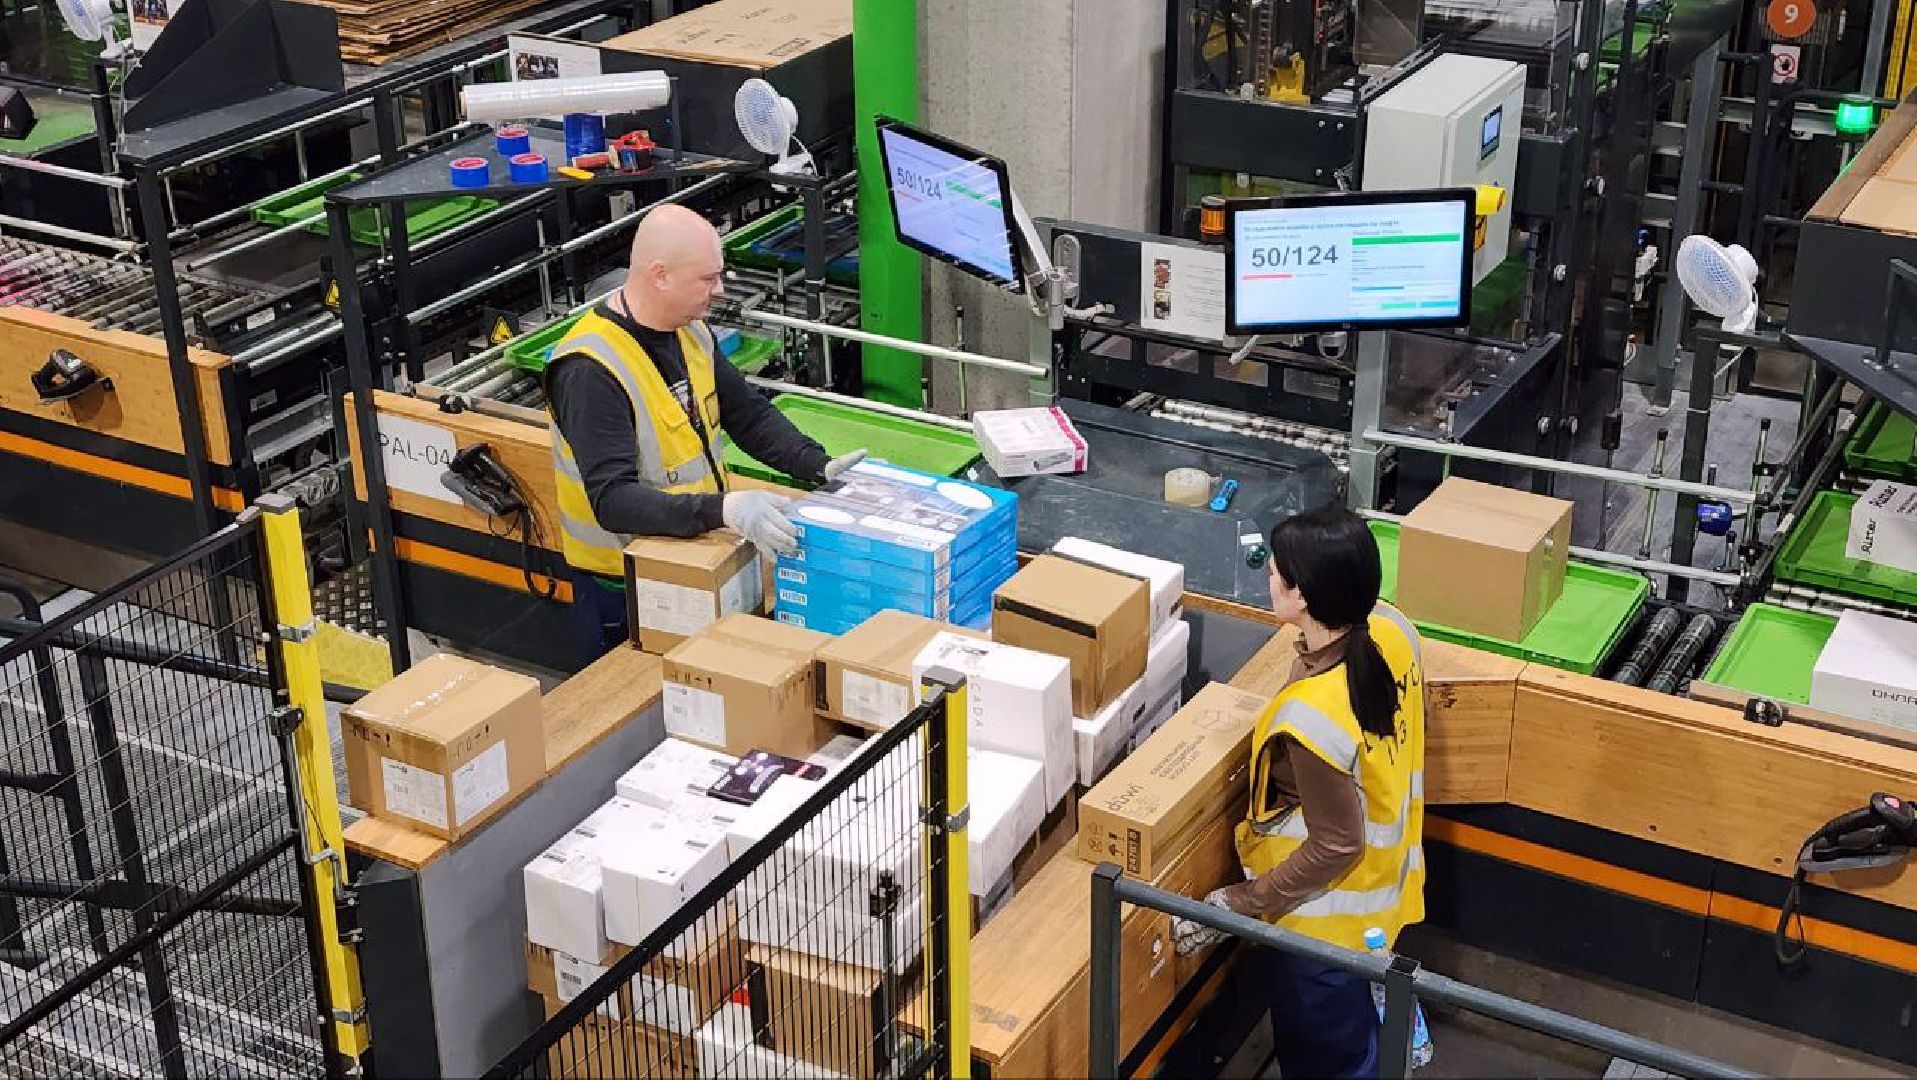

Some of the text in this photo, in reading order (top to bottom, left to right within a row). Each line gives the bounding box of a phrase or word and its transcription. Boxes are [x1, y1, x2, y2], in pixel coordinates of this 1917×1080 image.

[1785, 4, 1799, 24] 9
[897, 166, 943, 200] 50/124
[1251, 244, 1339, 267] 50/124
